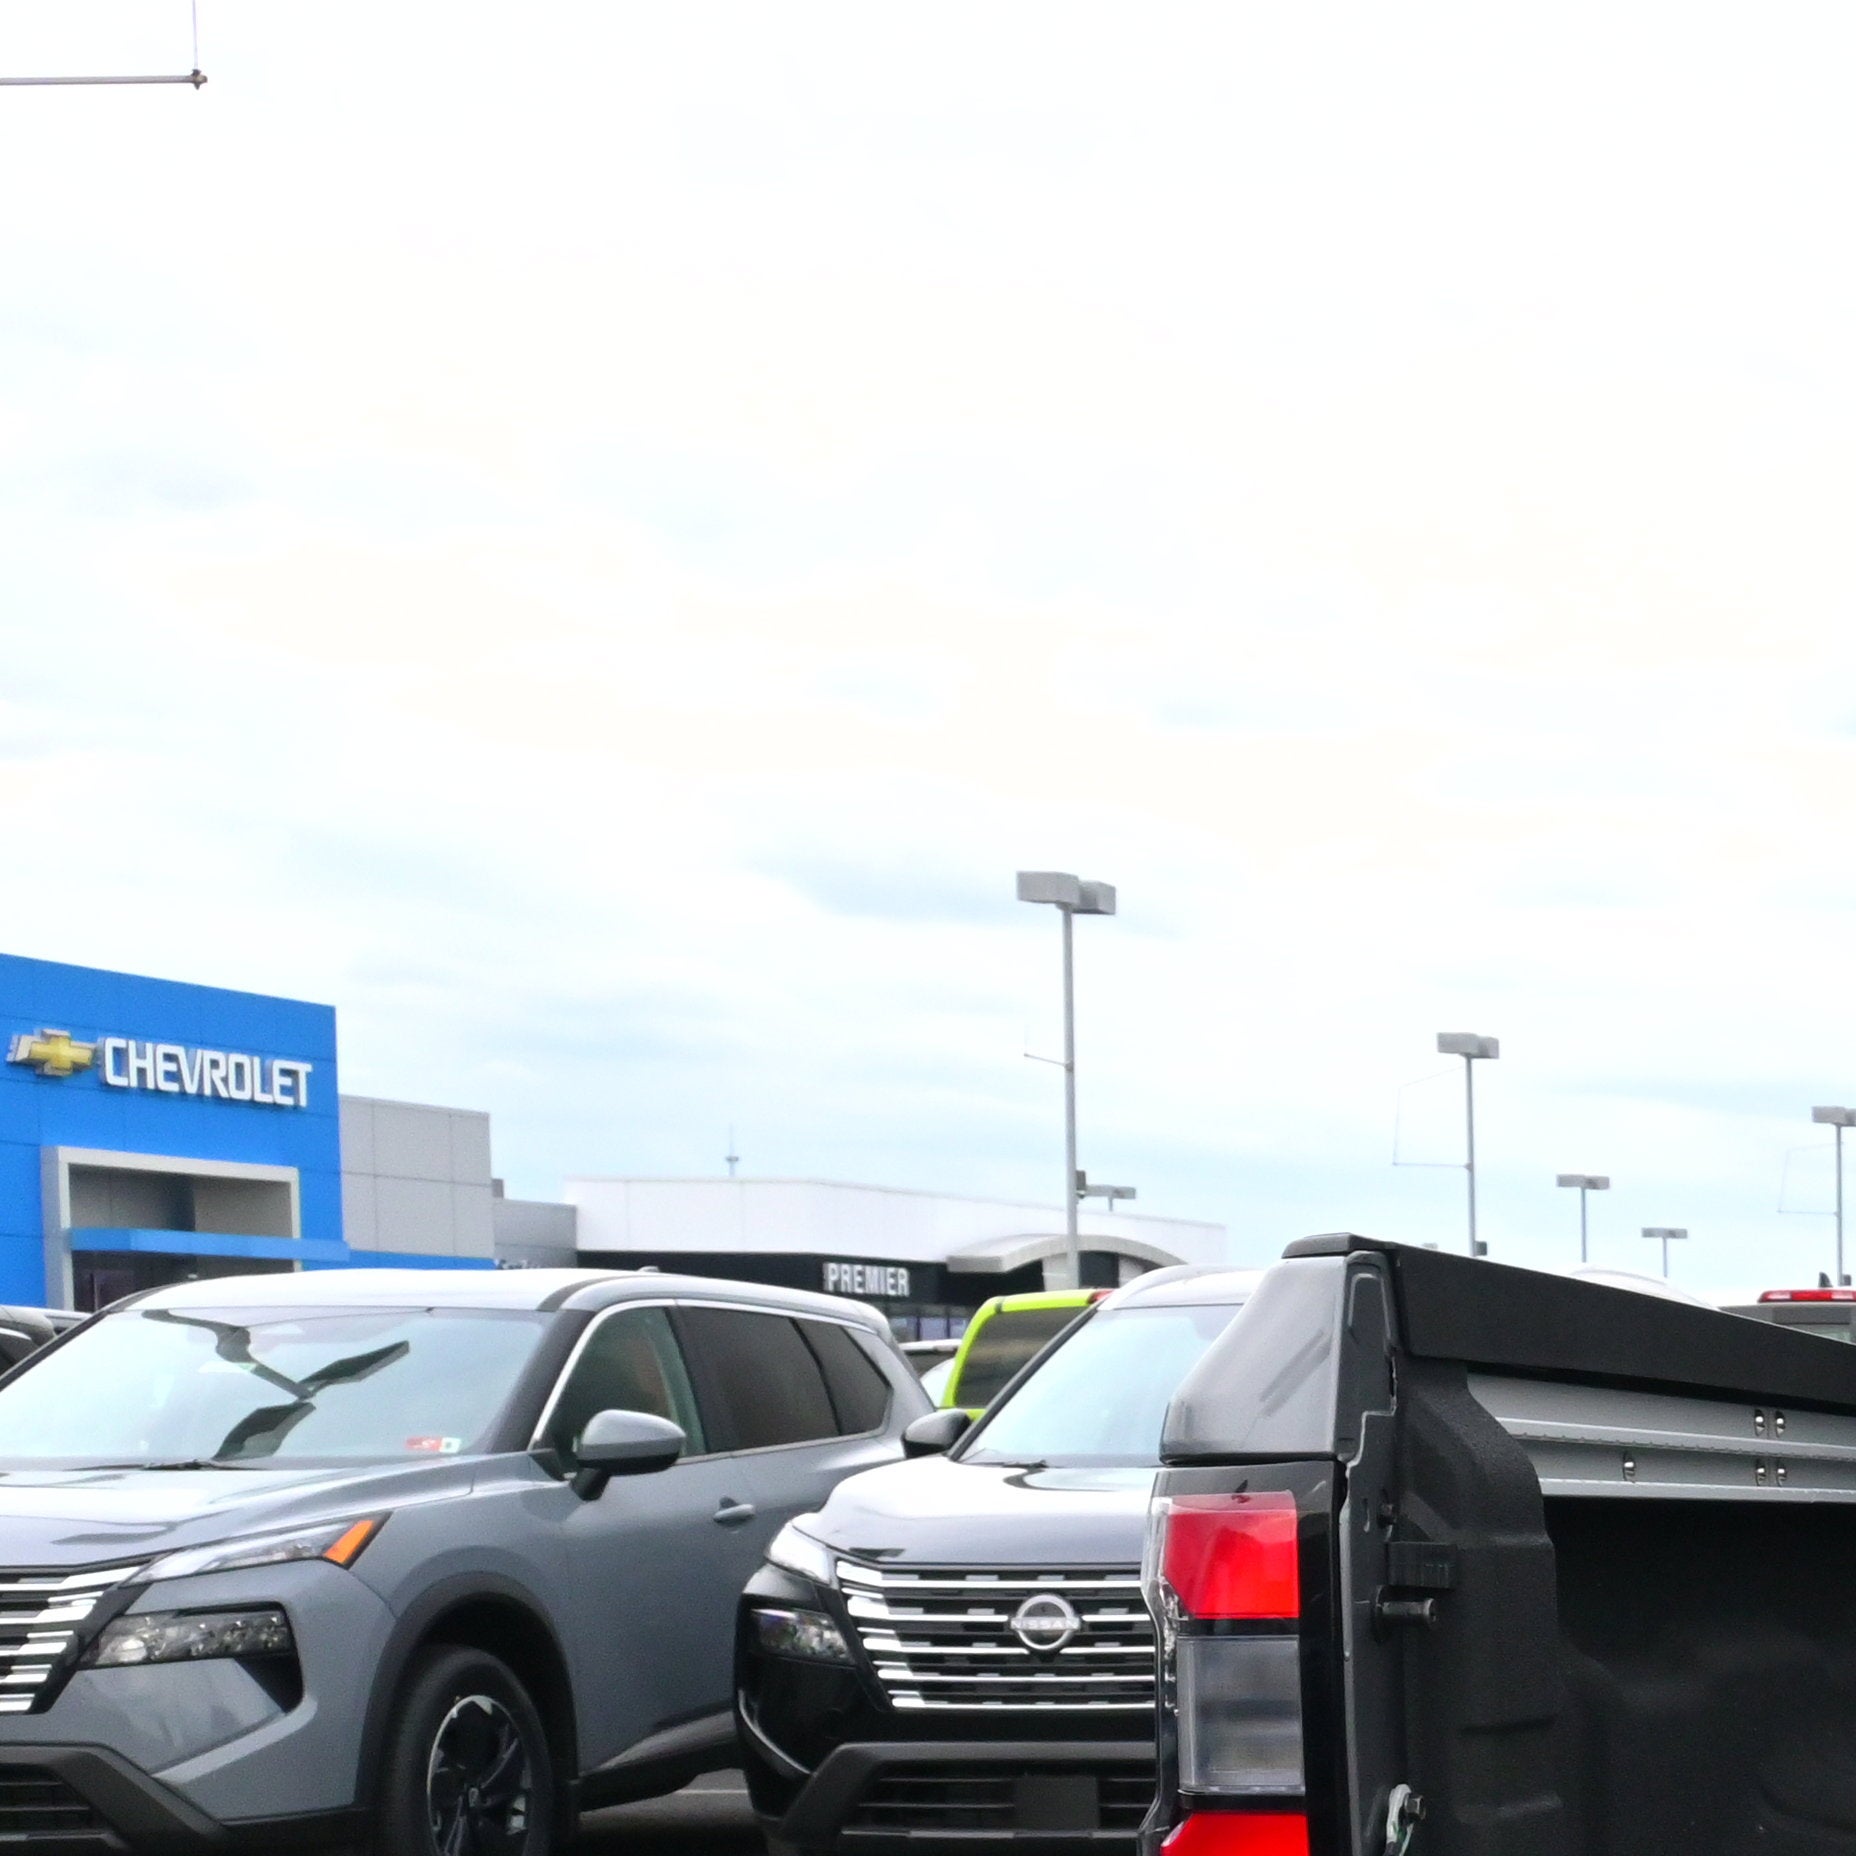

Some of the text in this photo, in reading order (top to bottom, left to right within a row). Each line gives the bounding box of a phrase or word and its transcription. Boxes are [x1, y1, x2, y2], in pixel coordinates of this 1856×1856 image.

[103, 1036, 313, 1108] CHEVROLET
[824, 1262, 910, 1297] PREMIER
[1010, 1618, 1080, 1630] NISSAN
